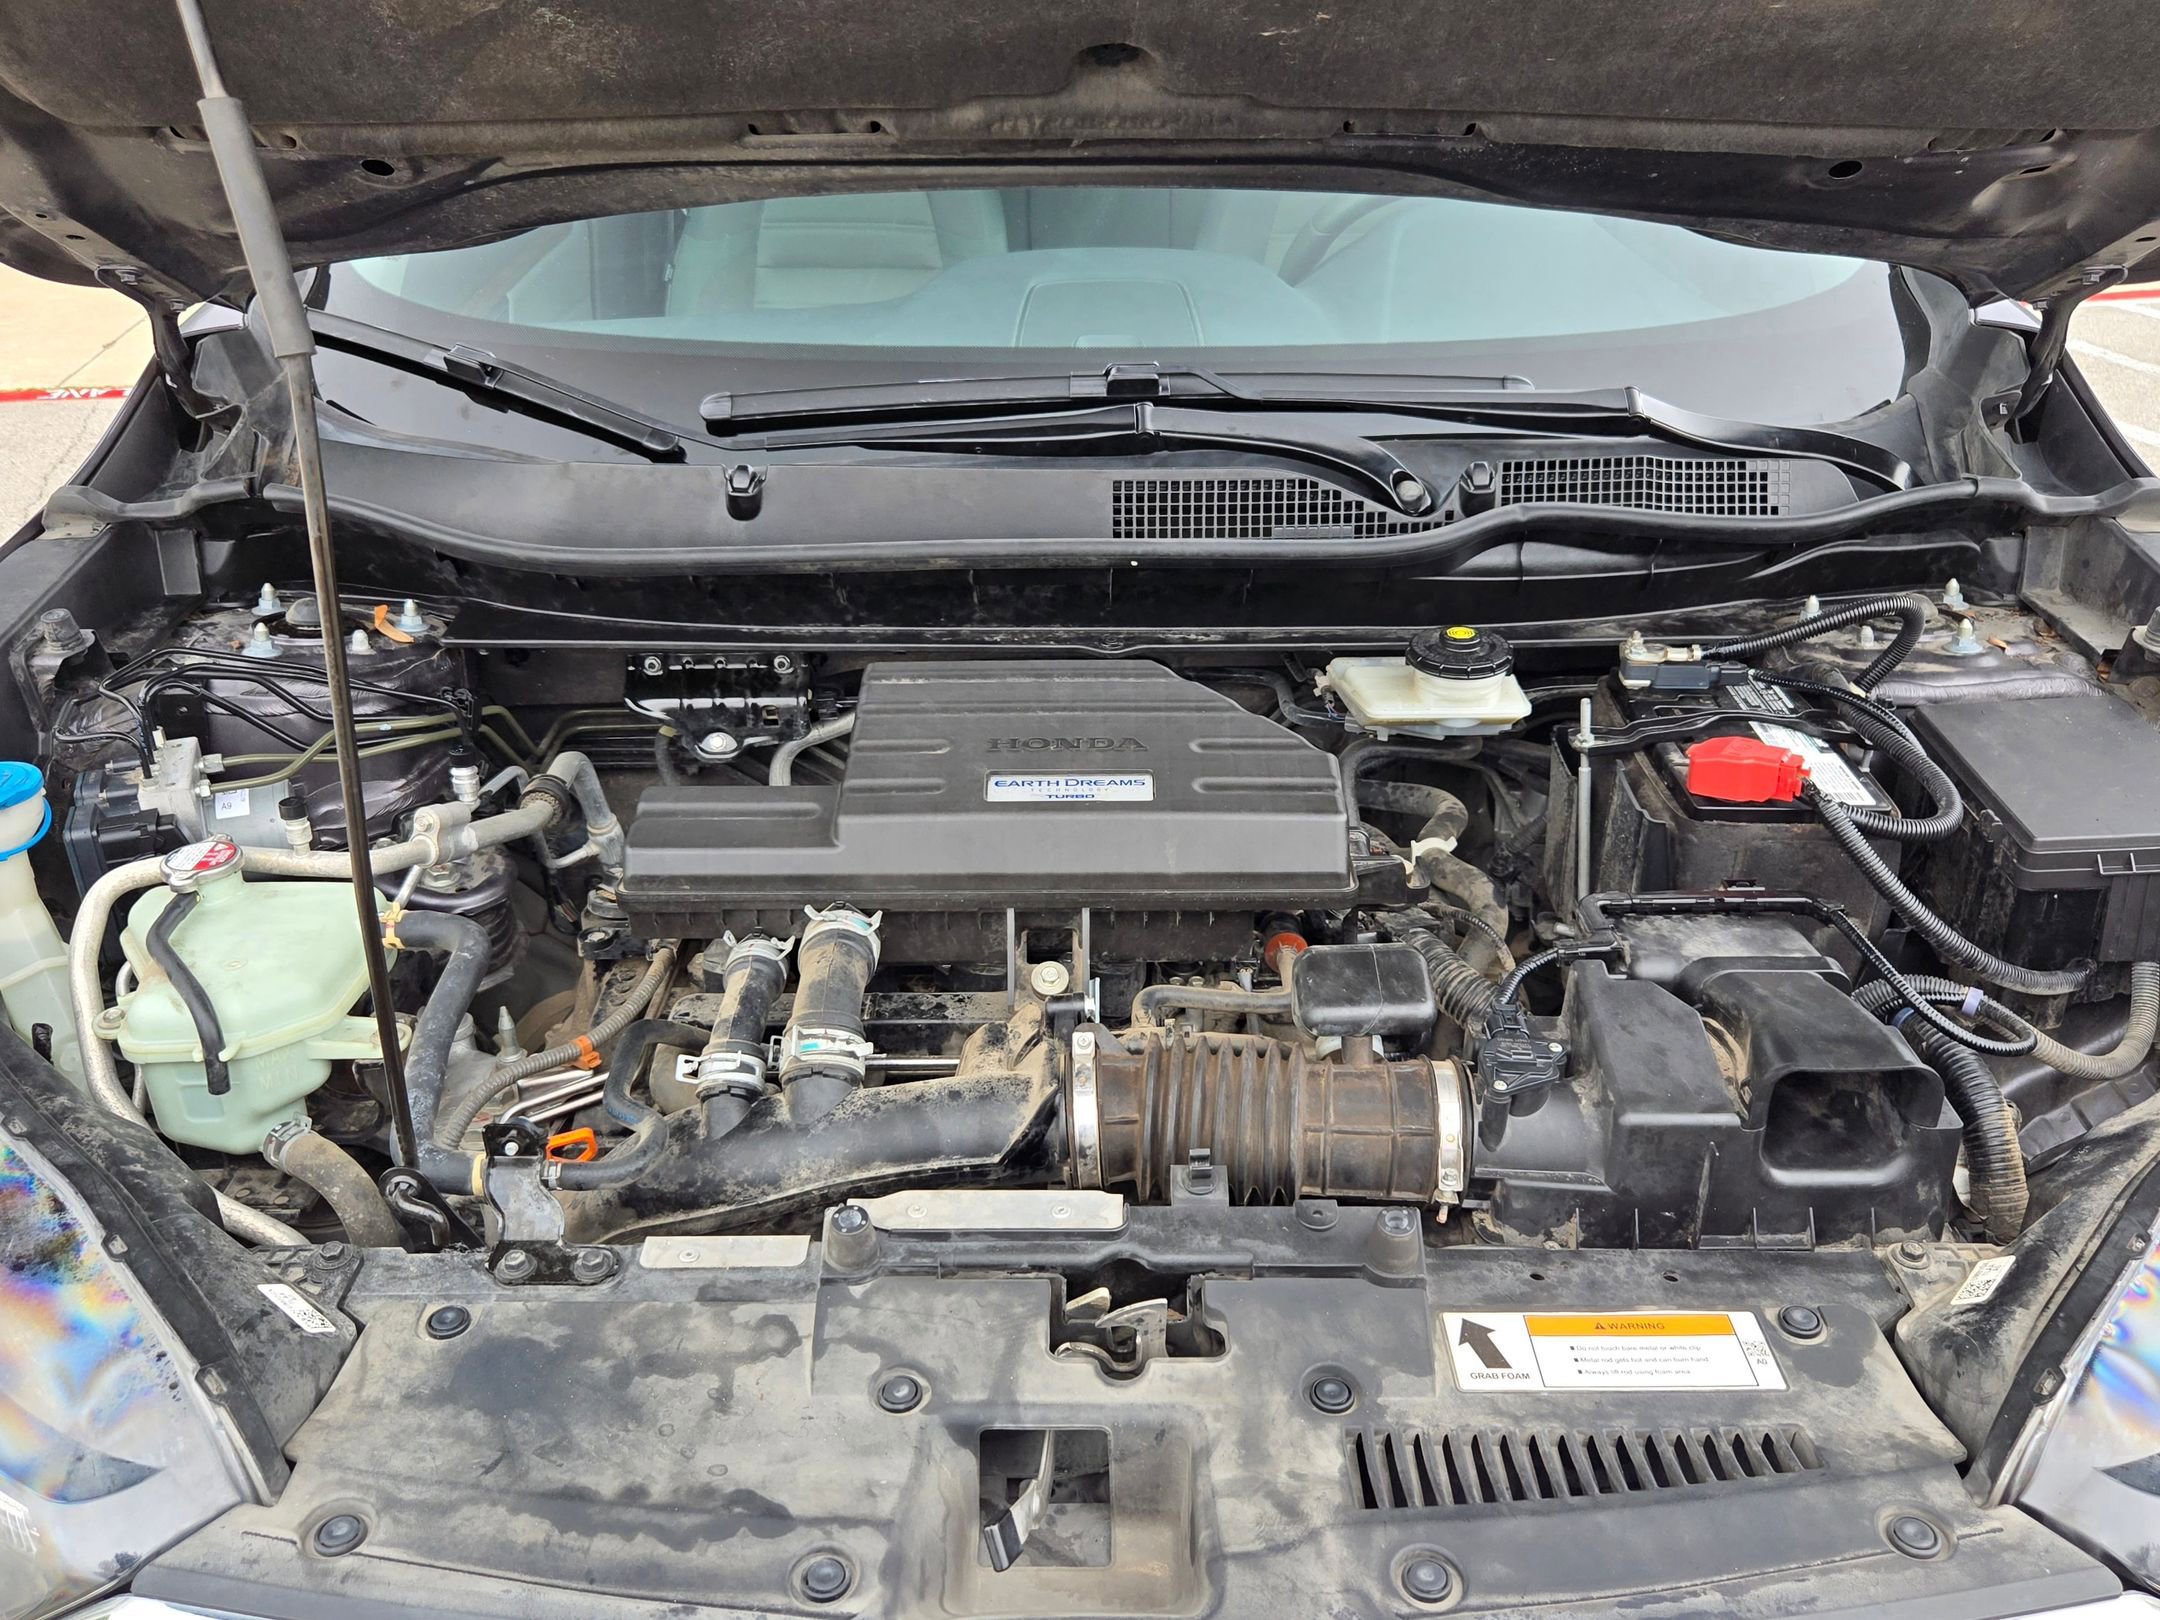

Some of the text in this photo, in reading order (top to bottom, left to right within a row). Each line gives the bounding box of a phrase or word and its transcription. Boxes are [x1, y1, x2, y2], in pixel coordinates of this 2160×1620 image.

[987, 737, 1148, 751] HONDA
[994, 778, 1146, 787] EARTH DREAMS
[1607, 1322, 1665, 1330] WARNING
[1470, 1372, 1530, 1380] GRAB FOAM
